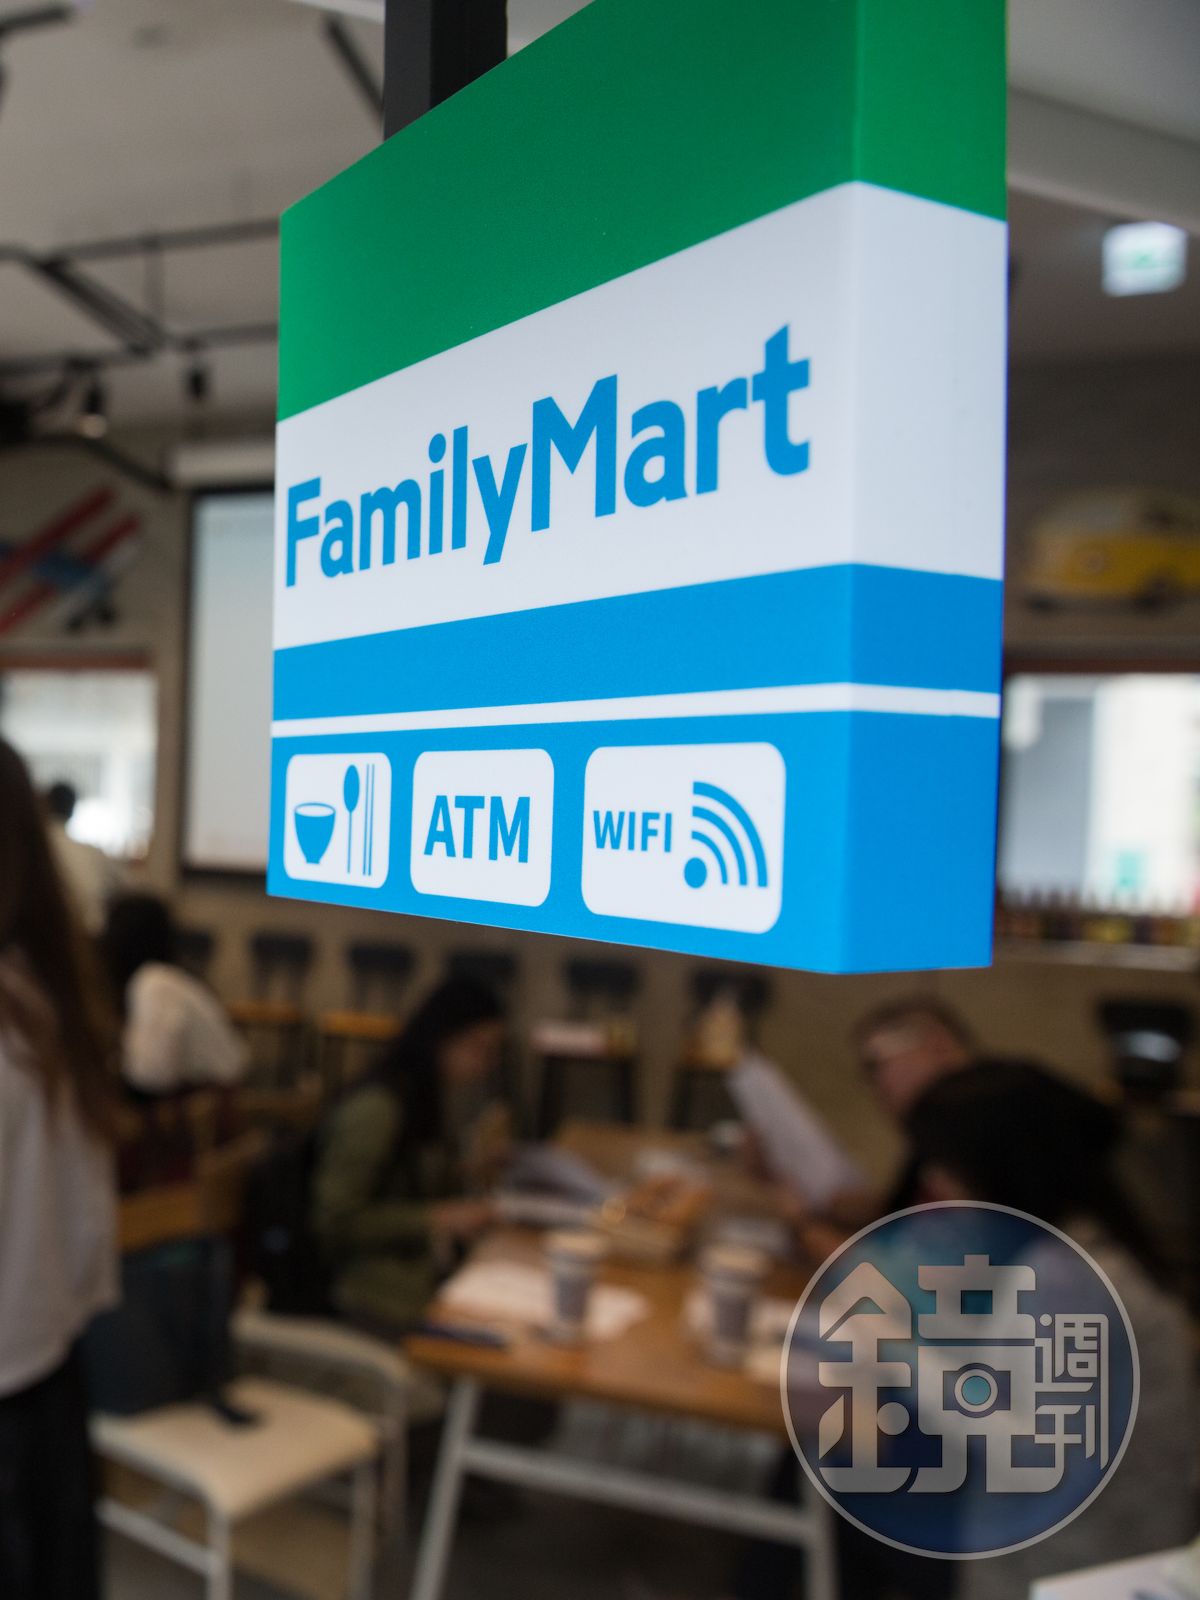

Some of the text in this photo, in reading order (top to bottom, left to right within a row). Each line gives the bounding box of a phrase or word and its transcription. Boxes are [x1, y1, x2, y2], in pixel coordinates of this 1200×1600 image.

[285, 323, 811, 588] FamilyMart
[423, 794, 531, 864] ATM
[592, 809, 673, 853] WIFI
